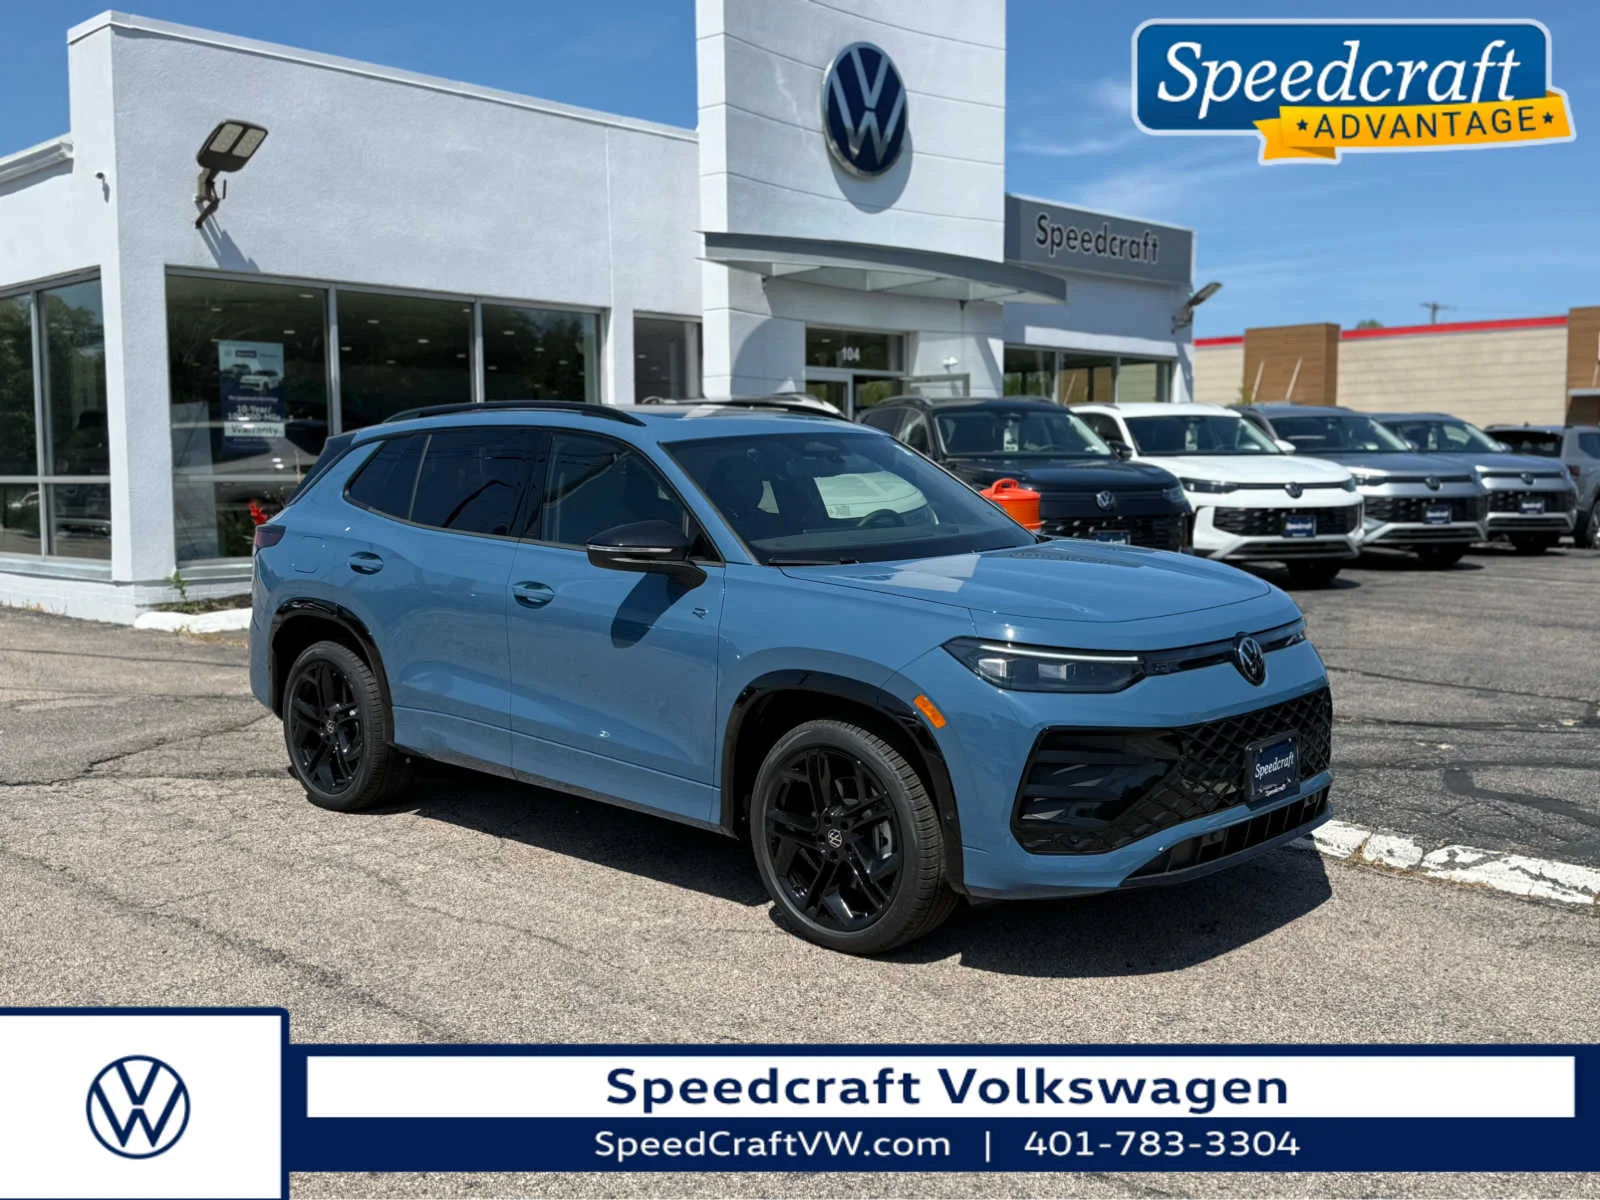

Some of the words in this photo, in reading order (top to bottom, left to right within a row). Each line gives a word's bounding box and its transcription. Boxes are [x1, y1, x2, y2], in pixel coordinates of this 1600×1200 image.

[1035, 212, 1159, 263] Speedcraft
[841, 346, 861, 361] 104
[1254, 751, 1294, 780] Speedcraft
